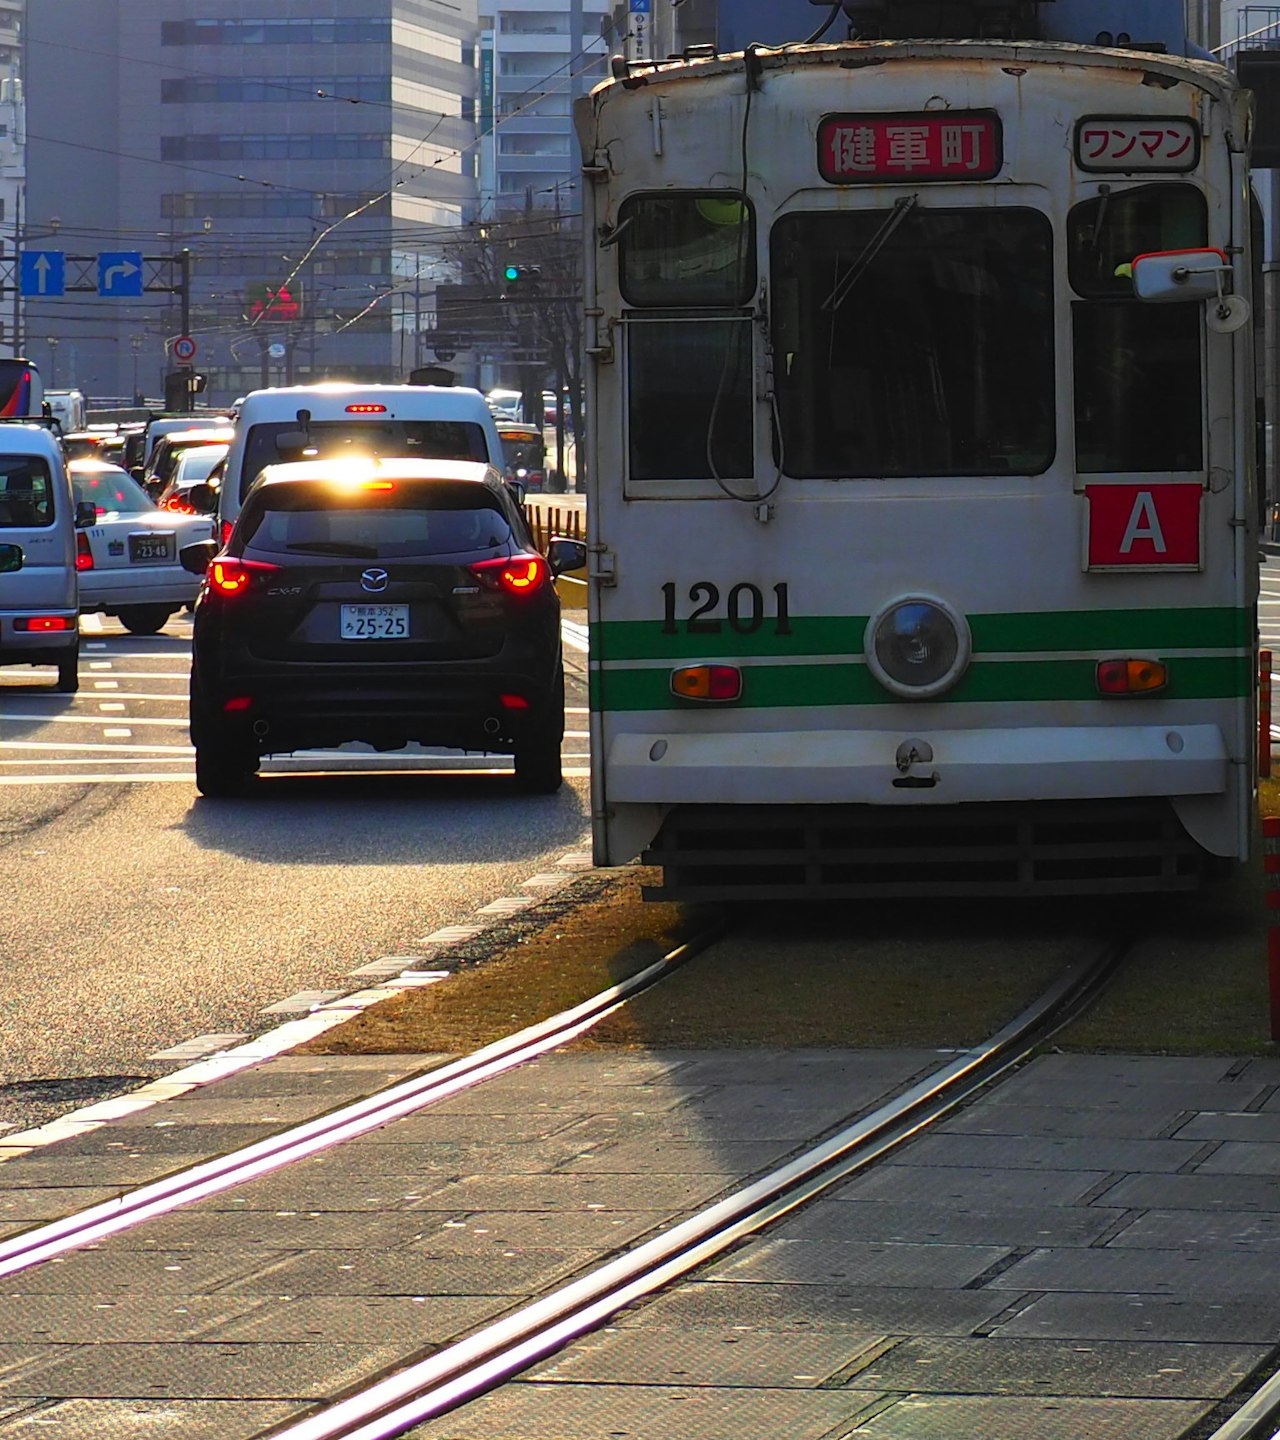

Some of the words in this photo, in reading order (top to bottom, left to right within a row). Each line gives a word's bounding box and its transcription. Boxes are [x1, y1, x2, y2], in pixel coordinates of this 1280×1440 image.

[831, 126, 985, 173] 健軍町
[1083, 128, 1192, 160] ワンマン
[1120, 492, 1166, 553] A
[356, 618, 405, 635] 25-25
[661, 582, 792, 635] 1201
